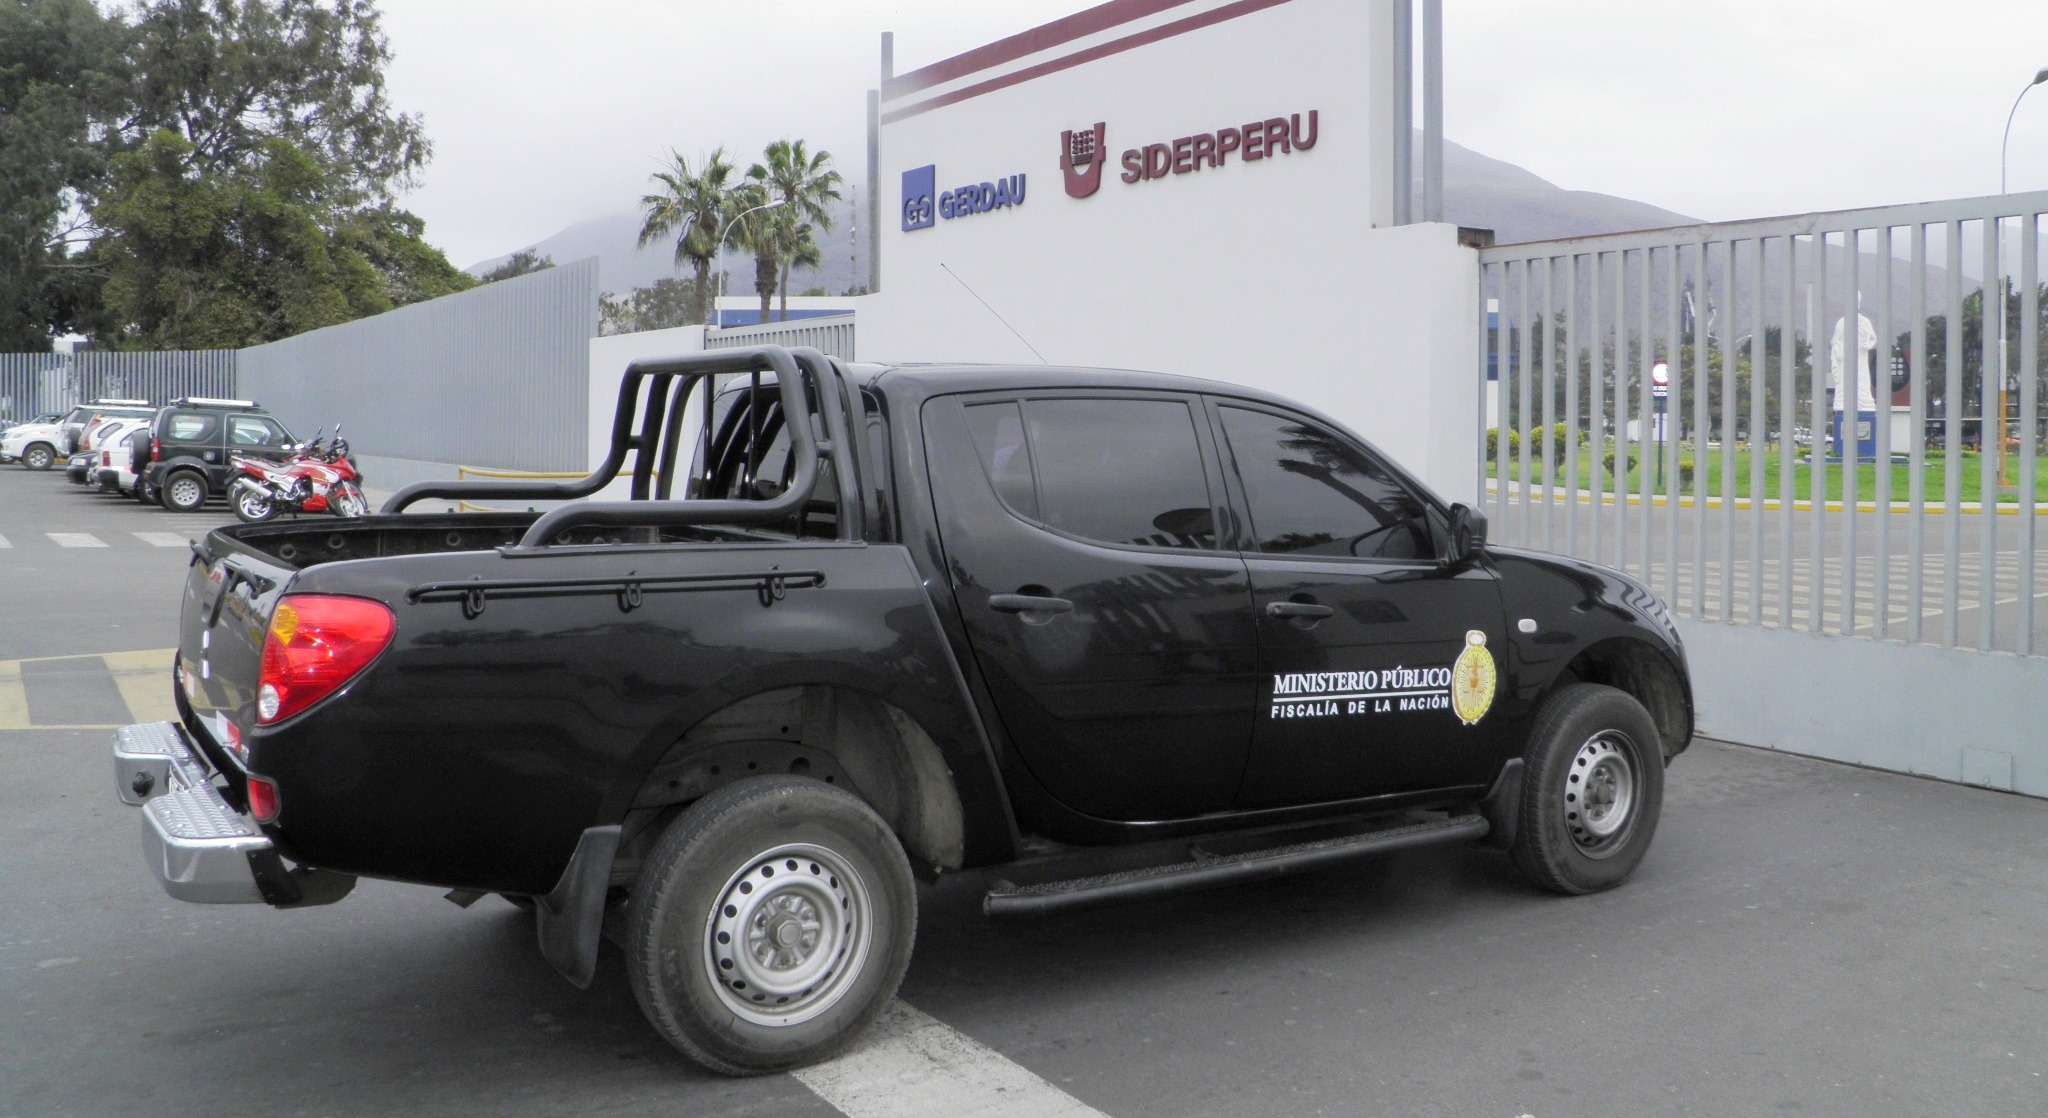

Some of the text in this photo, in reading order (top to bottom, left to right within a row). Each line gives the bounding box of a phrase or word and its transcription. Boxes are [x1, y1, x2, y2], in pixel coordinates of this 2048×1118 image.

[1120, 109, 1319, 184] SIDERPERU
[939, 173, 1026, 219] GERDAU
[1273, 665, 1451, 694] MINISTERIO PÚBLICO
[1271, 694, 1449, 719] FISCALÍA DE LA NACIÓN
